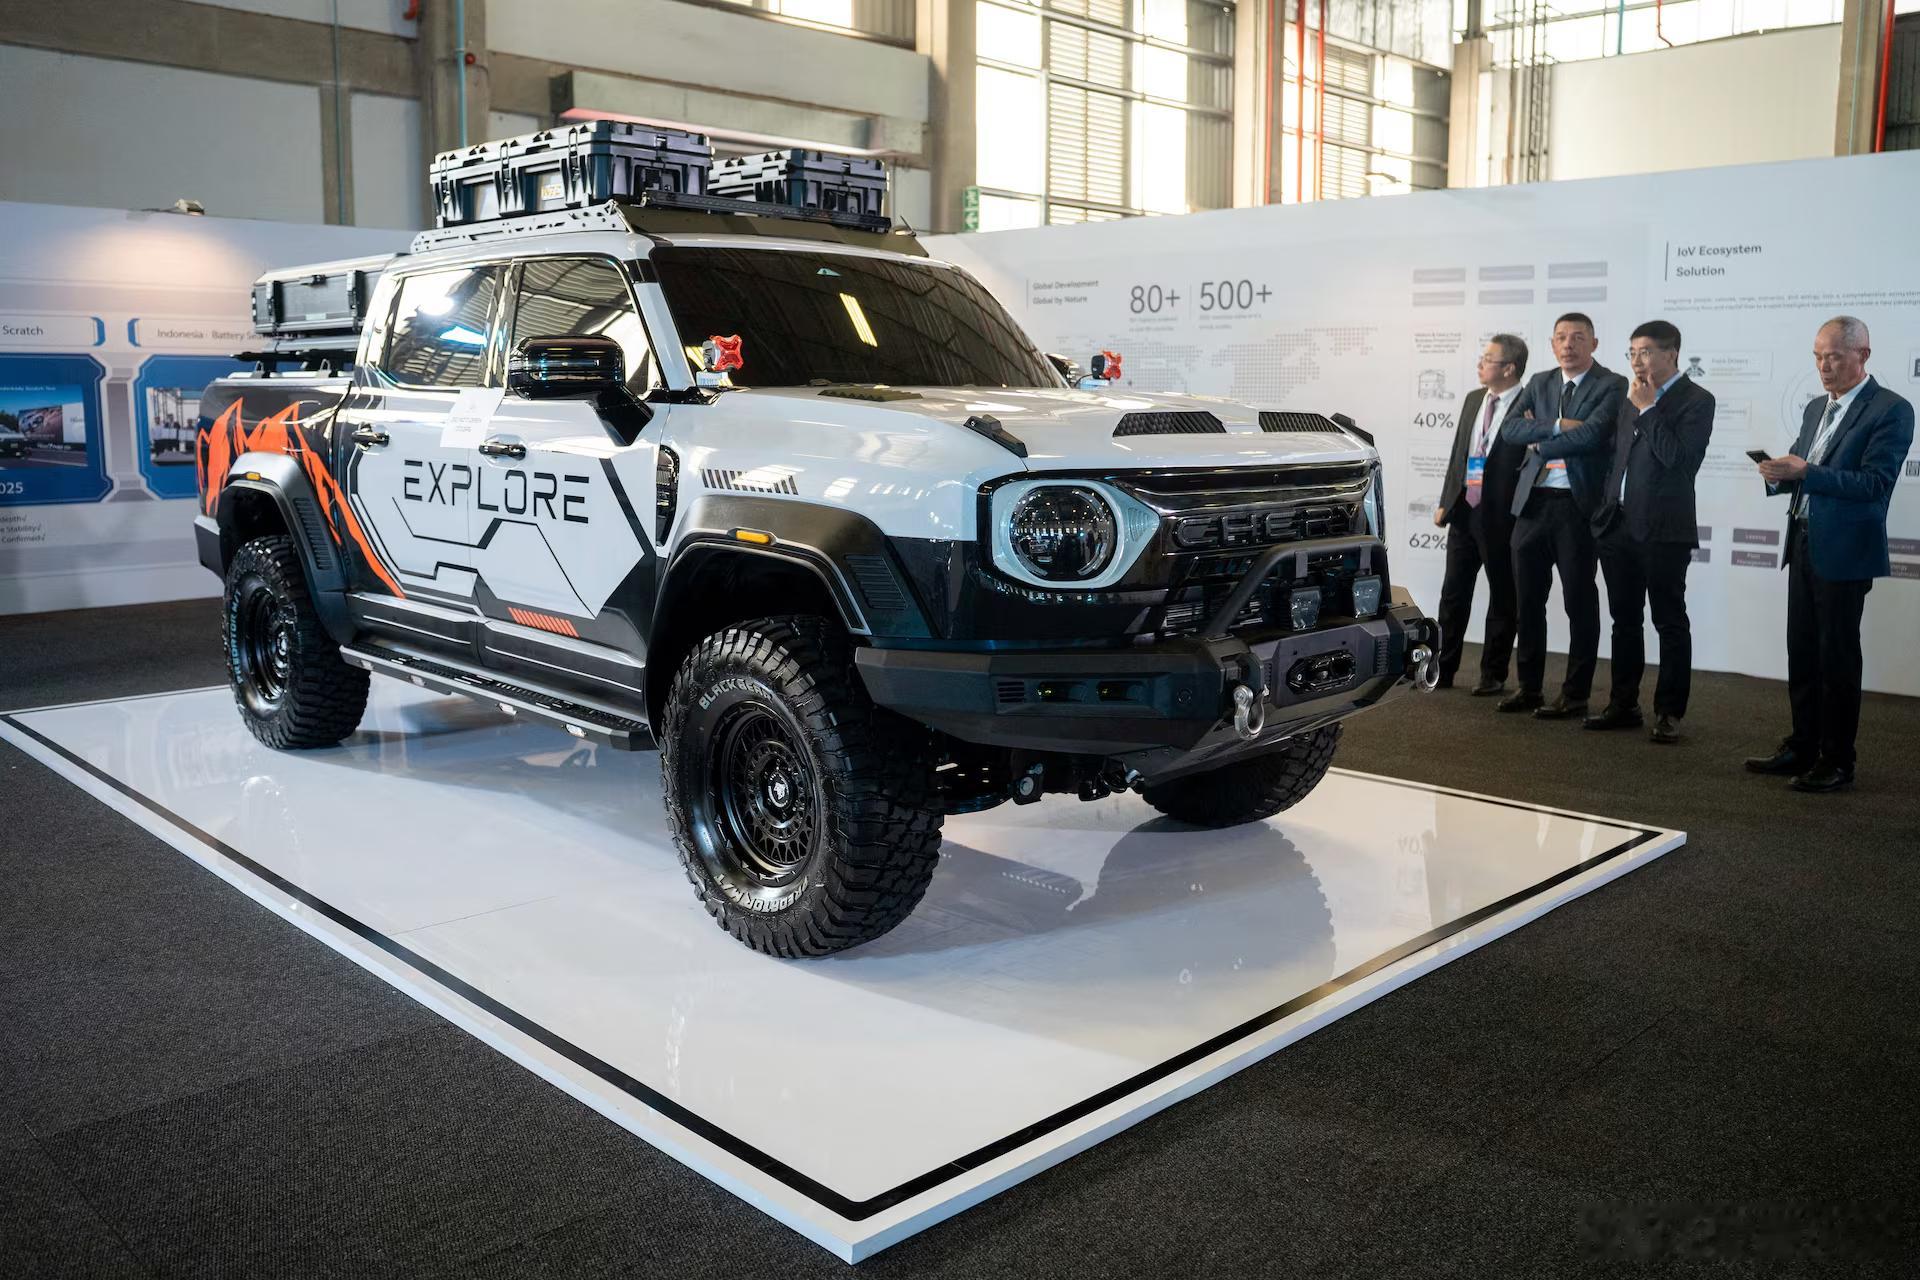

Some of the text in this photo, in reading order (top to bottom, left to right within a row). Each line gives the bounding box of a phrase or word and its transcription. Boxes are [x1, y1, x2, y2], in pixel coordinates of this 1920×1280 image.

[1677, 243, 1762, 257] IoV Ecosystem
[1676, 265, 1725, 277] Solution
[1032, 280, 1099, 290] Global Development
[1032, 295, 1088, 306] Global by Nature
[1130, 284, 1181, 314] 80+
[1199, 279, 1273, 311] 500+
[3, 325, 43, 336] Scratch
[157, 329, 203, 339] Indonesia
[211, 330, 244, 341] Battery
[1413, 412, 1454, 428] 40%
[404, 459, 590, 524] EXPLORE
[1175, 502, 1359, 547] CHERY
[1409, 533, 1448, 551] 62%
[746, 876, 809, 913] PREDATOR
